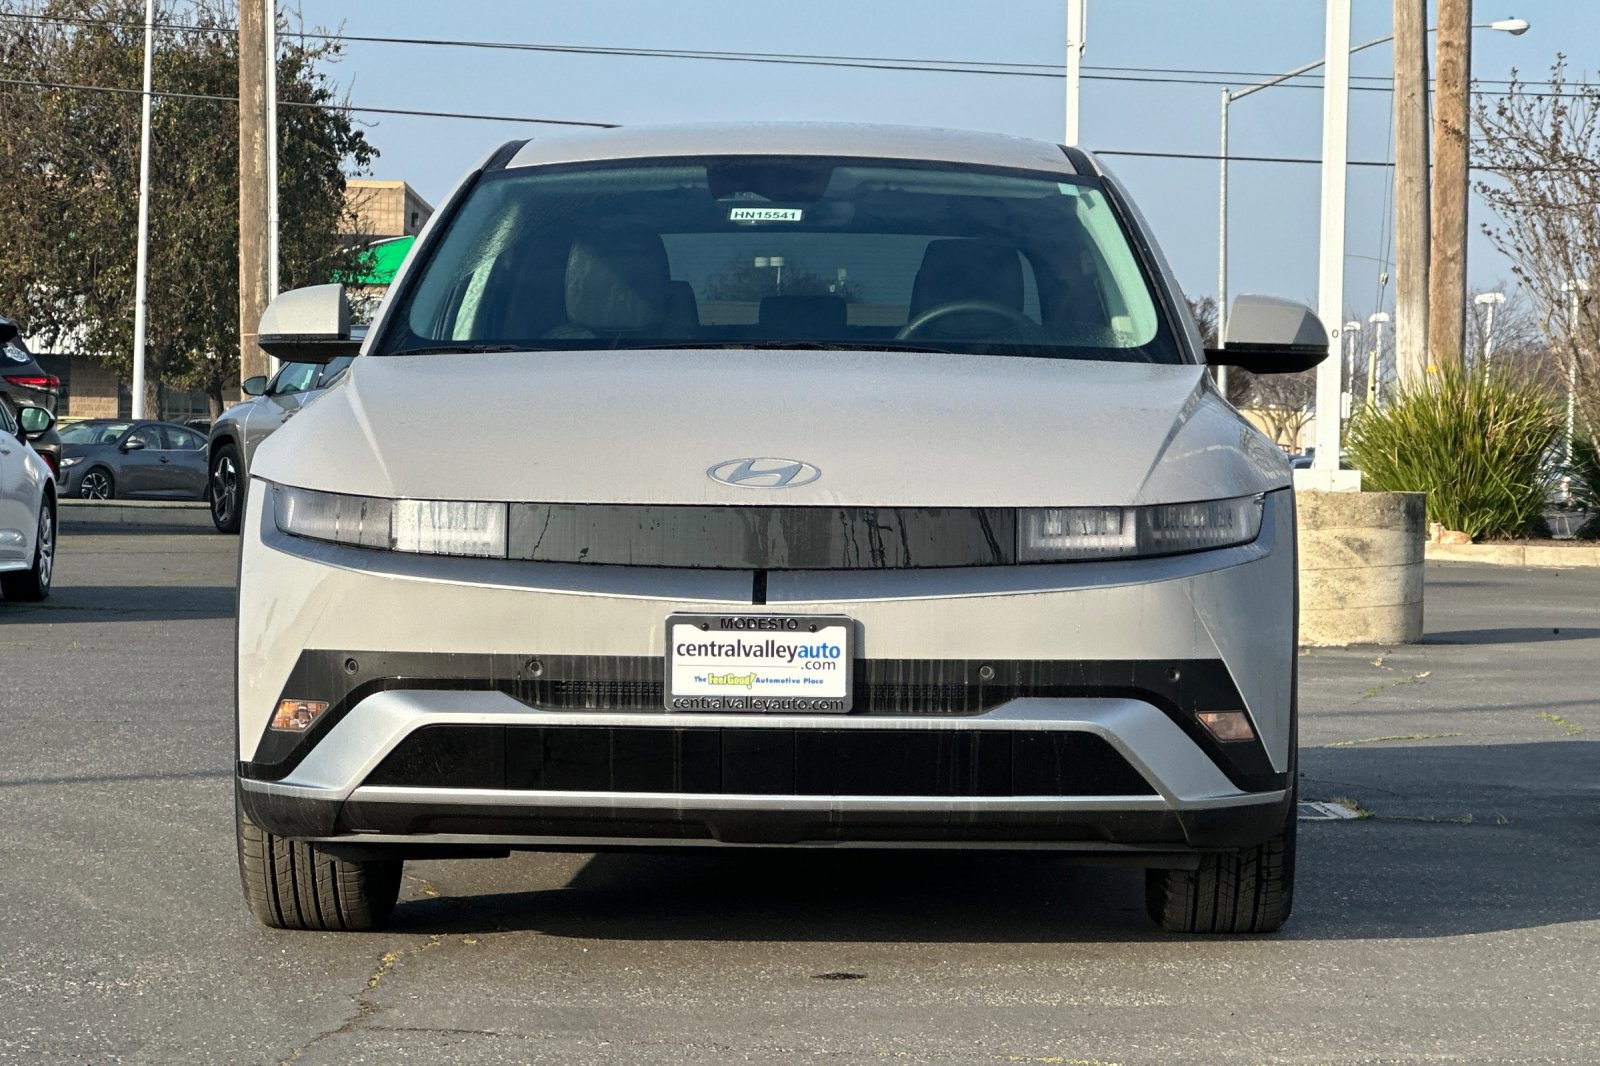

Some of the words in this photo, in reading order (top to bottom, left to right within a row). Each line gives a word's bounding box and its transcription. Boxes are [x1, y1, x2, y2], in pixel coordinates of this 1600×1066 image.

[734, 211, 796, 219] HN15541
[720, 618, 799, 630] MODESTO
[673, 696, 844, 712] centralvalleyauto.com
